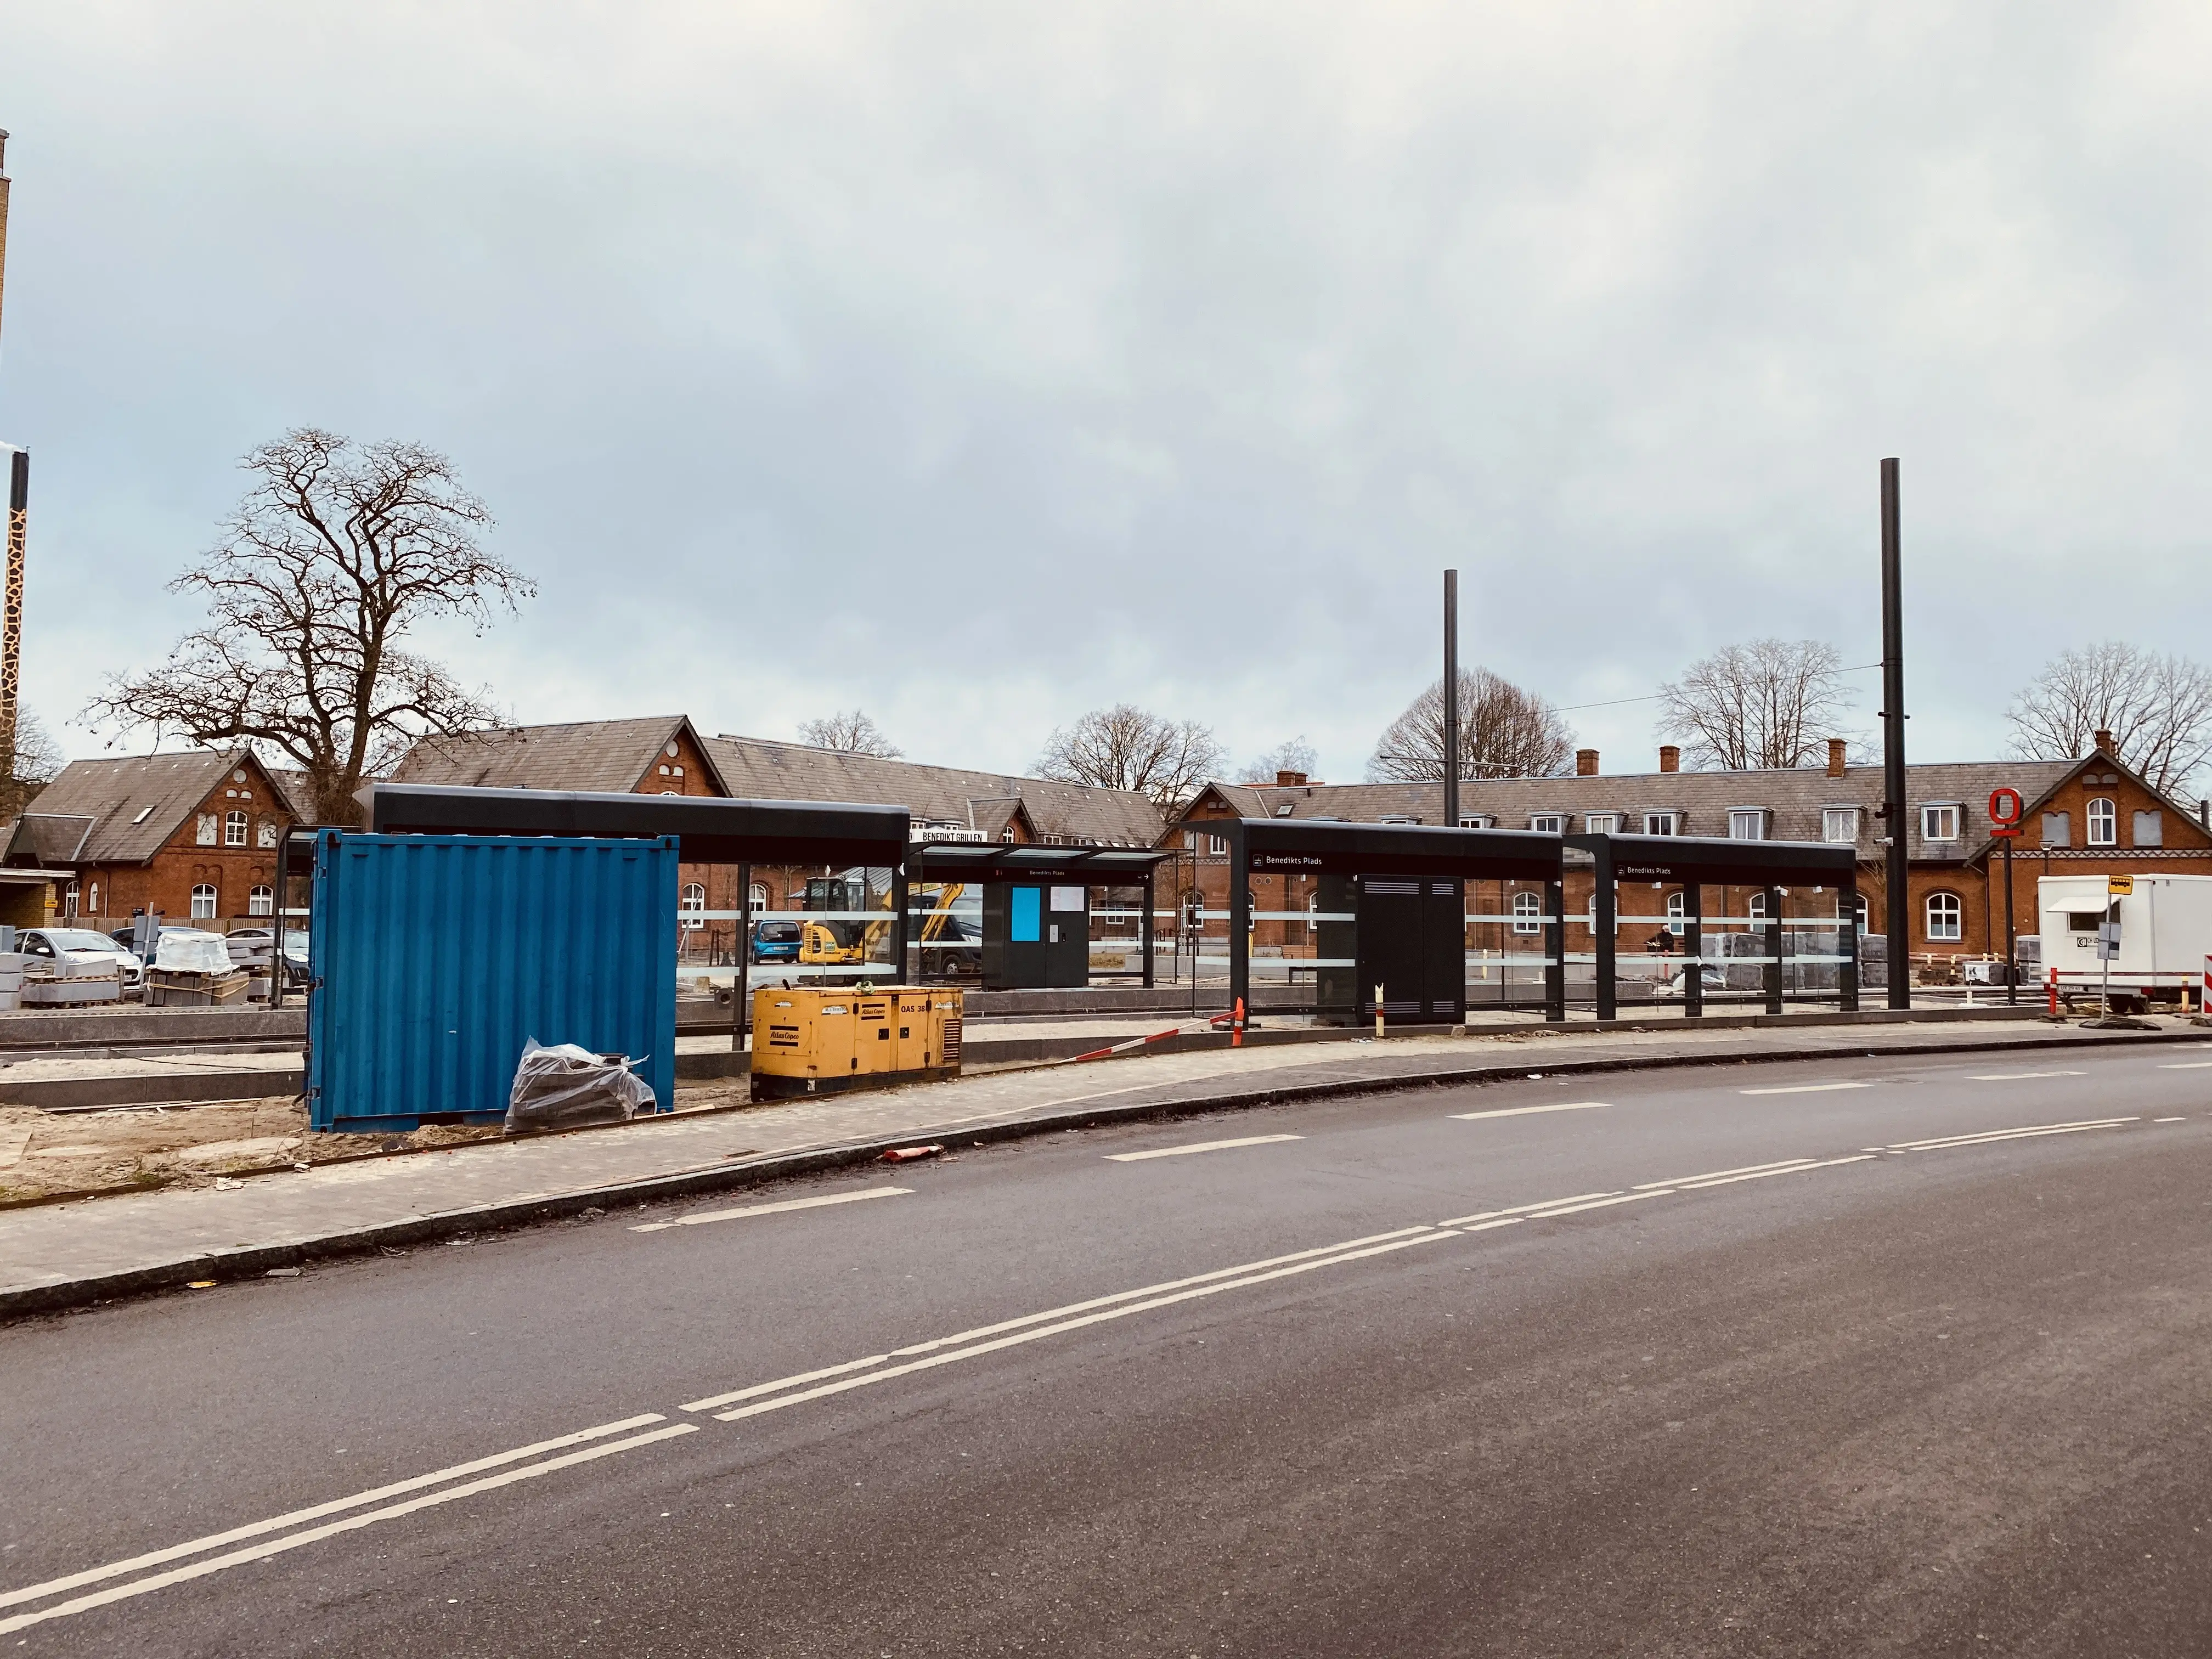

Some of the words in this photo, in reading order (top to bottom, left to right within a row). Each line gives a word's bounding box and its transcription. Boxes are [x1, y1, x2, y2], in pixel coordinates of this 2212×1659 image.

[923, 832, 955, 842] BENEDIKT
[956, 833, 982, 842] GRILLEN
[1266, 856, 1301, 864] Benedikts
[785, 1032, 799, 1040] Copco
